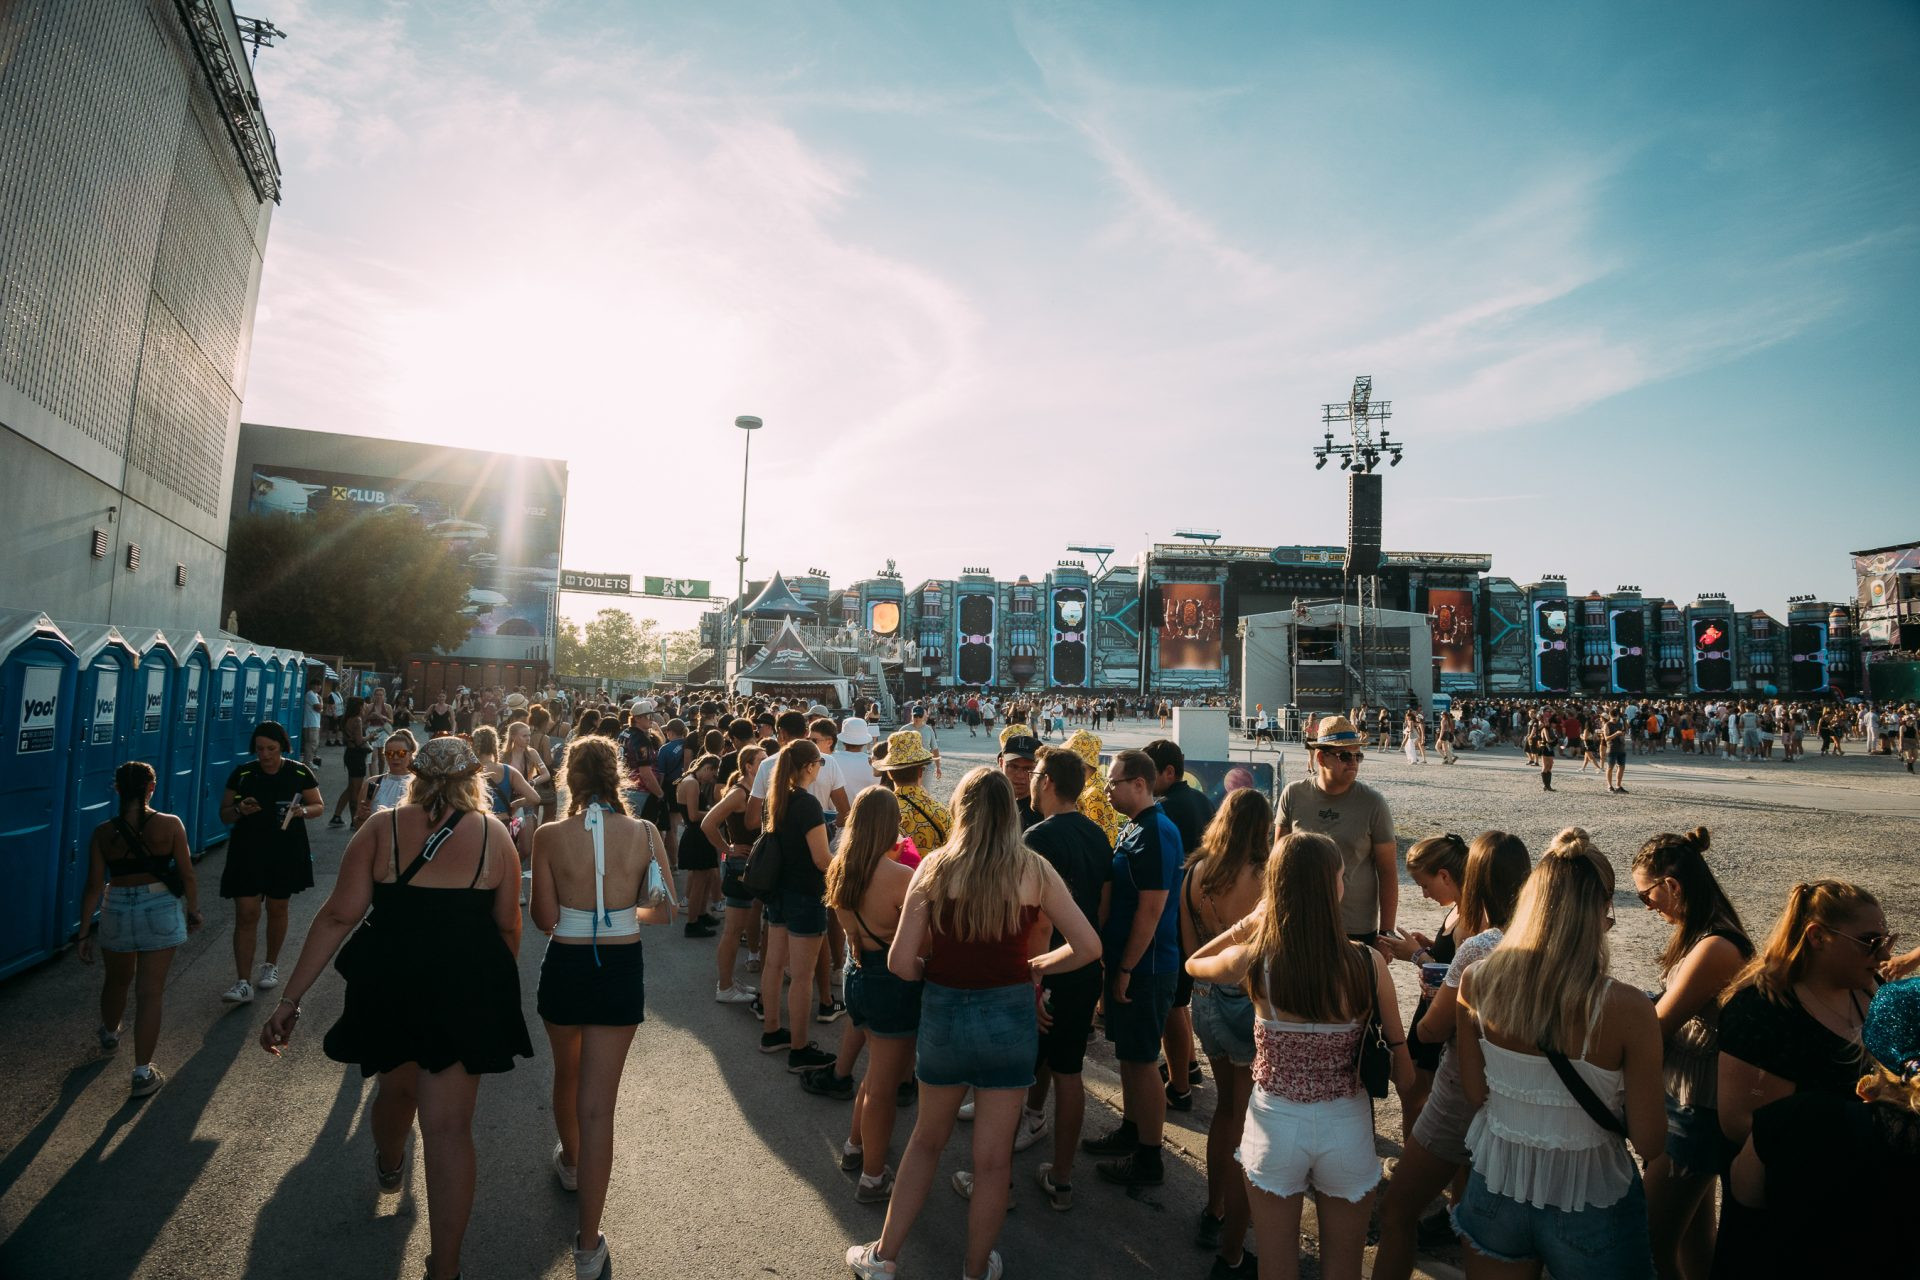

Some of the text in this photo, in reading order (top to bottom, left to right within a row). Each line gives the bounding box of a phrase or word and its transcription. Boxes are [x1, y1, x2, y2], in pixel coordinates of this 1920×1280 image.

[577, 576, 628, 589] TOILETS
[24, 696, 56, 723] yoo!
[96, 697, 116, 719] yoo!
